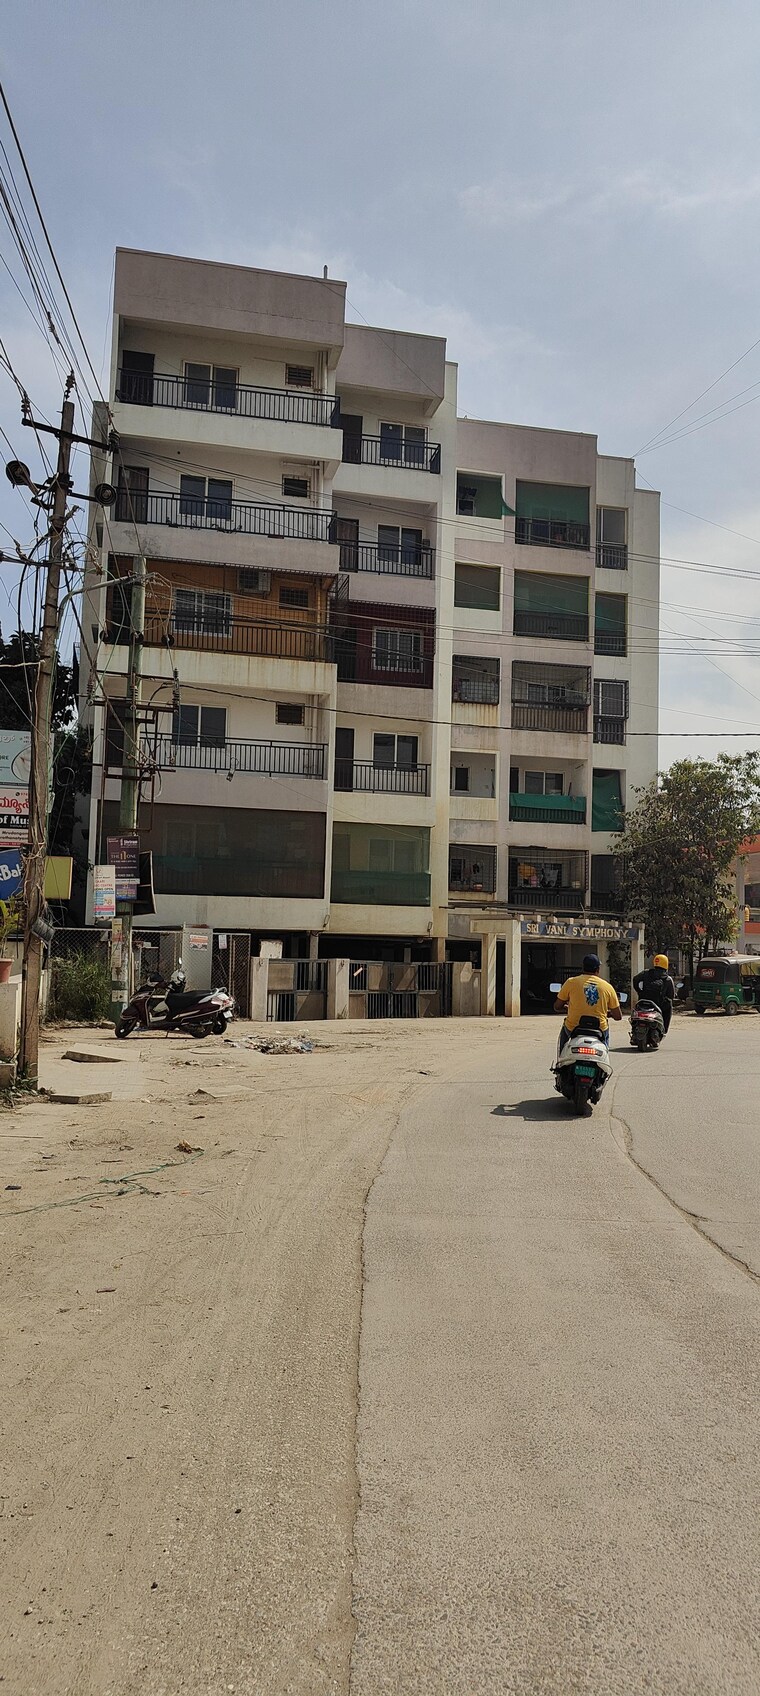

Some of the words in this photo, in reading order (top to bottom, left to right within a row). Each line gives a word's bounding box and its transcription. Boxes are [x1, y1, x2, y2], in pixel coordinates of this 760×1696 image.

[526, 923, 539, 933] SRI
[545, 924, 567, 935] VANI
[572, 926, 629, 939] SYMPHONY
